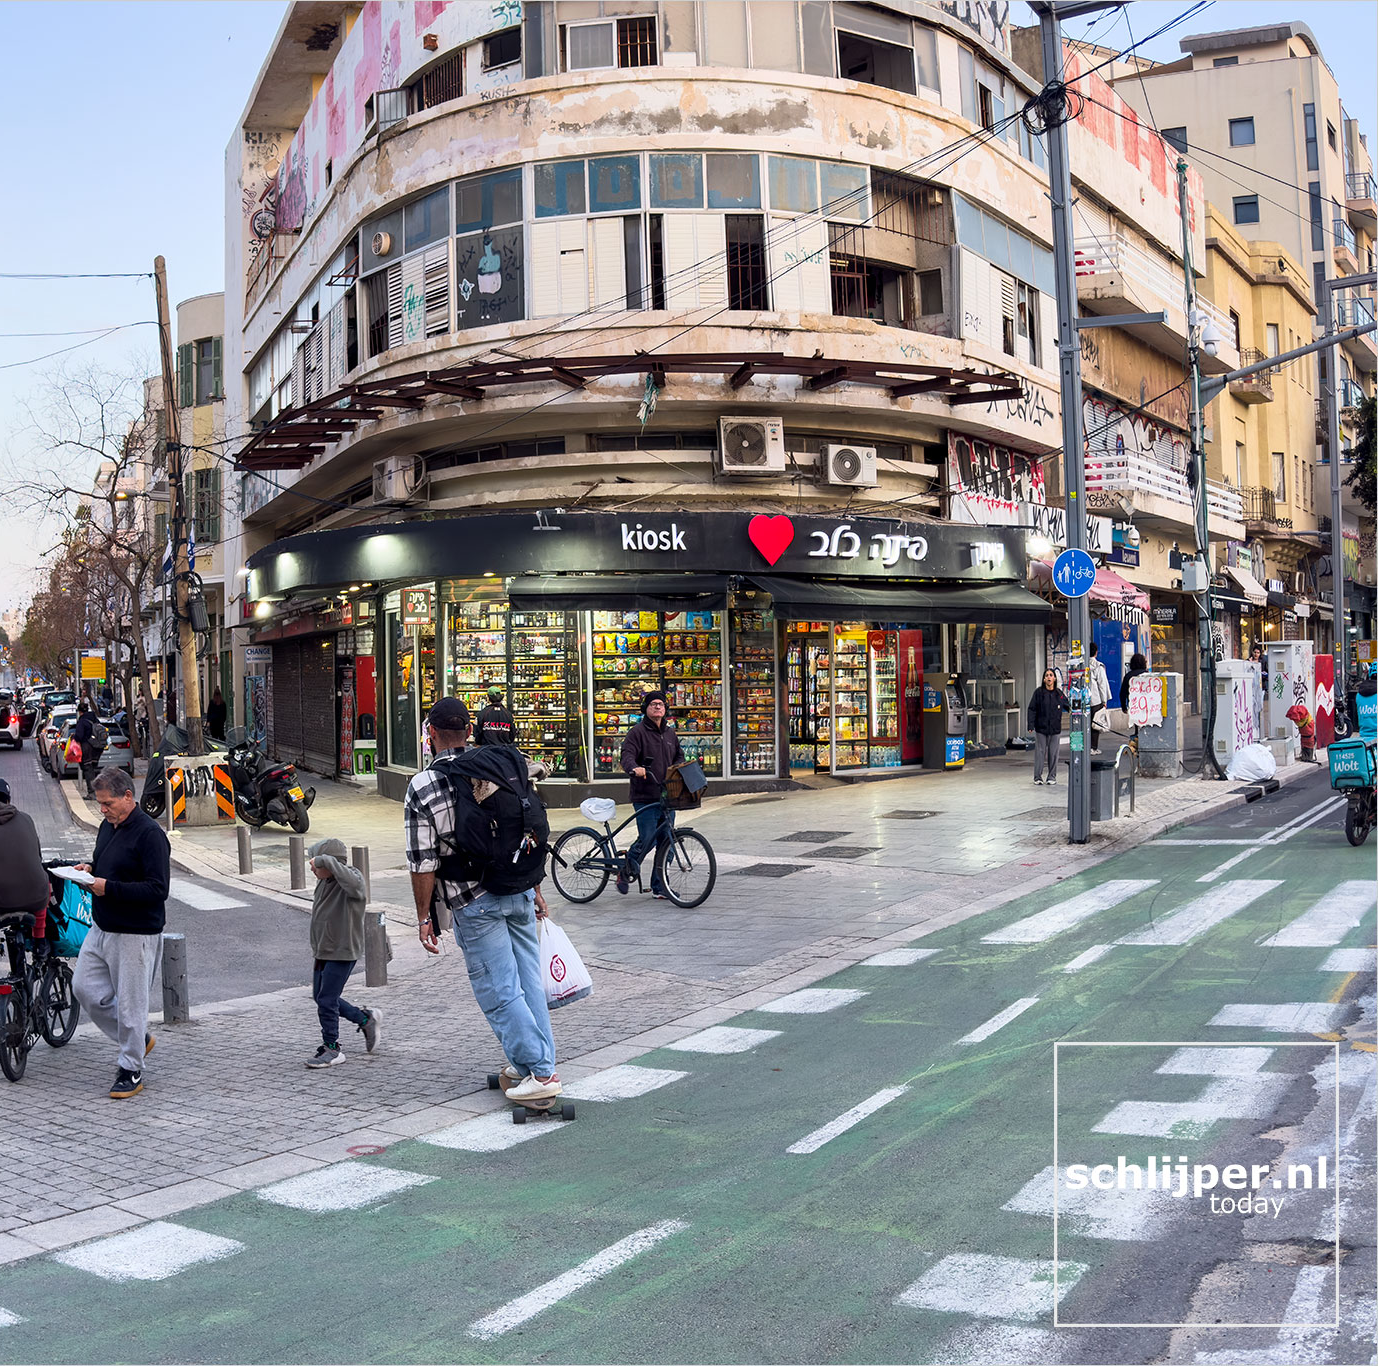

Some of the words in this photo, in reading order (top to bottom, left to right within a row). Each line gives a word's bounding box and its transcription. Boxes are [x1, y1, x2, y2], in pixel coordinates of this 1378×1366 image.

[621, 523, 687, 551] kiosk
[808, 525, 861, 558] בלב
[1334, 760, 1360, 773] Wolt
